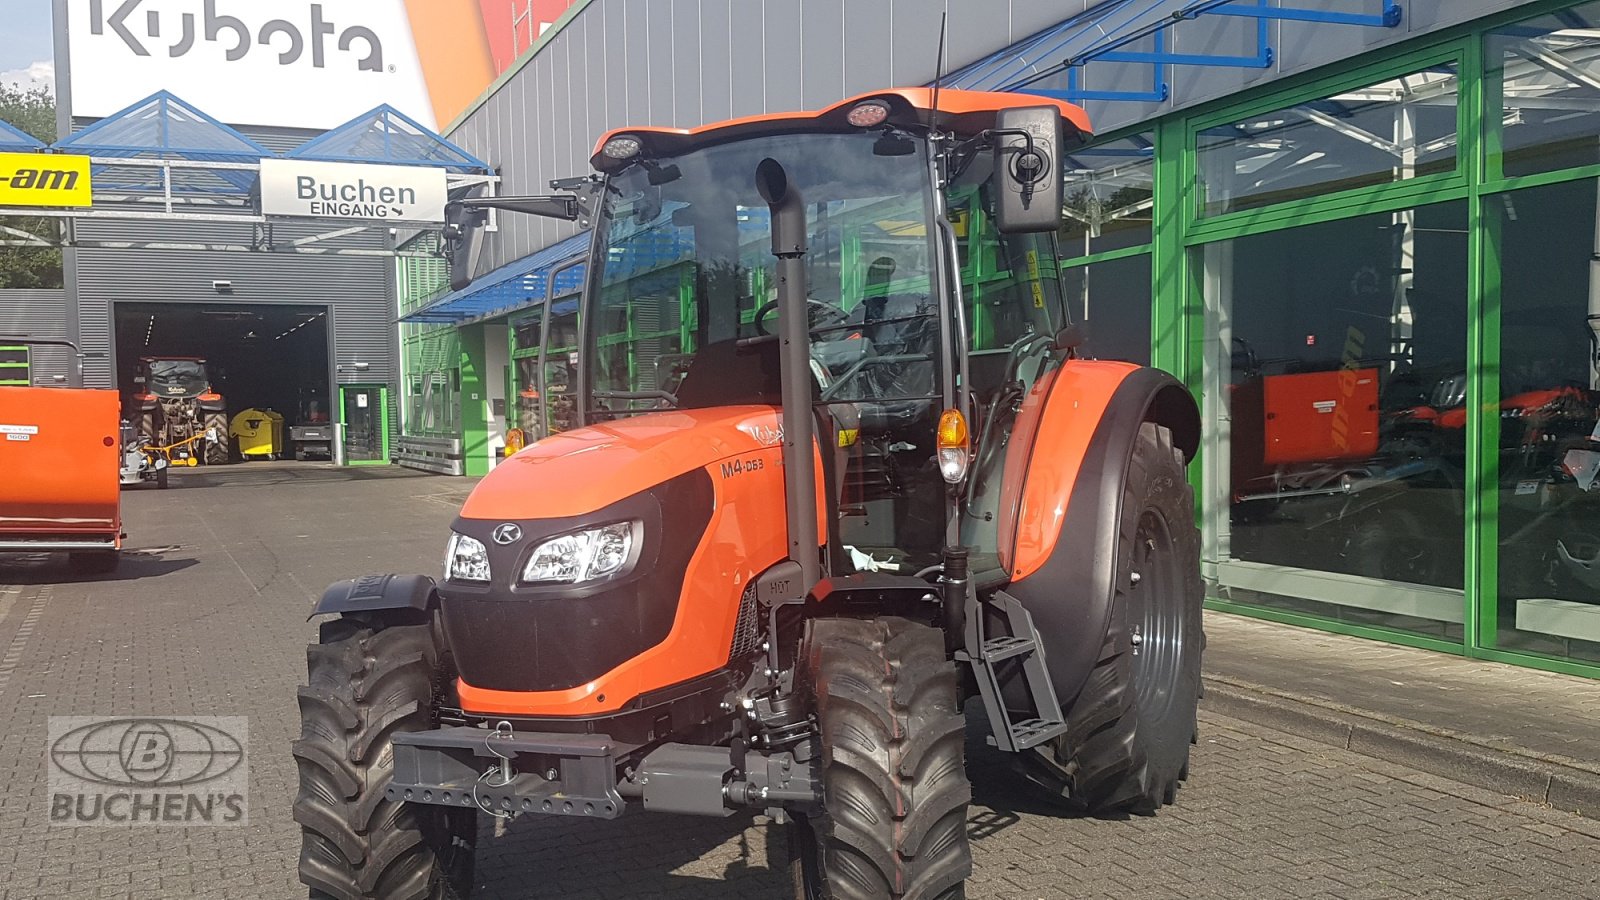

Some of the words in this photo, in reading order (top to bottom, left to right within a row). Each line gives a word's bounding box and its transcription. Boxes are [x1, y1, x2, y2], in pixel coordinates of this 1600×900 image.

[297, 175, 416, 205] Buchen
[310, 201, 388, 217] EINGANG
[770, 580, 790, 594] HOT
